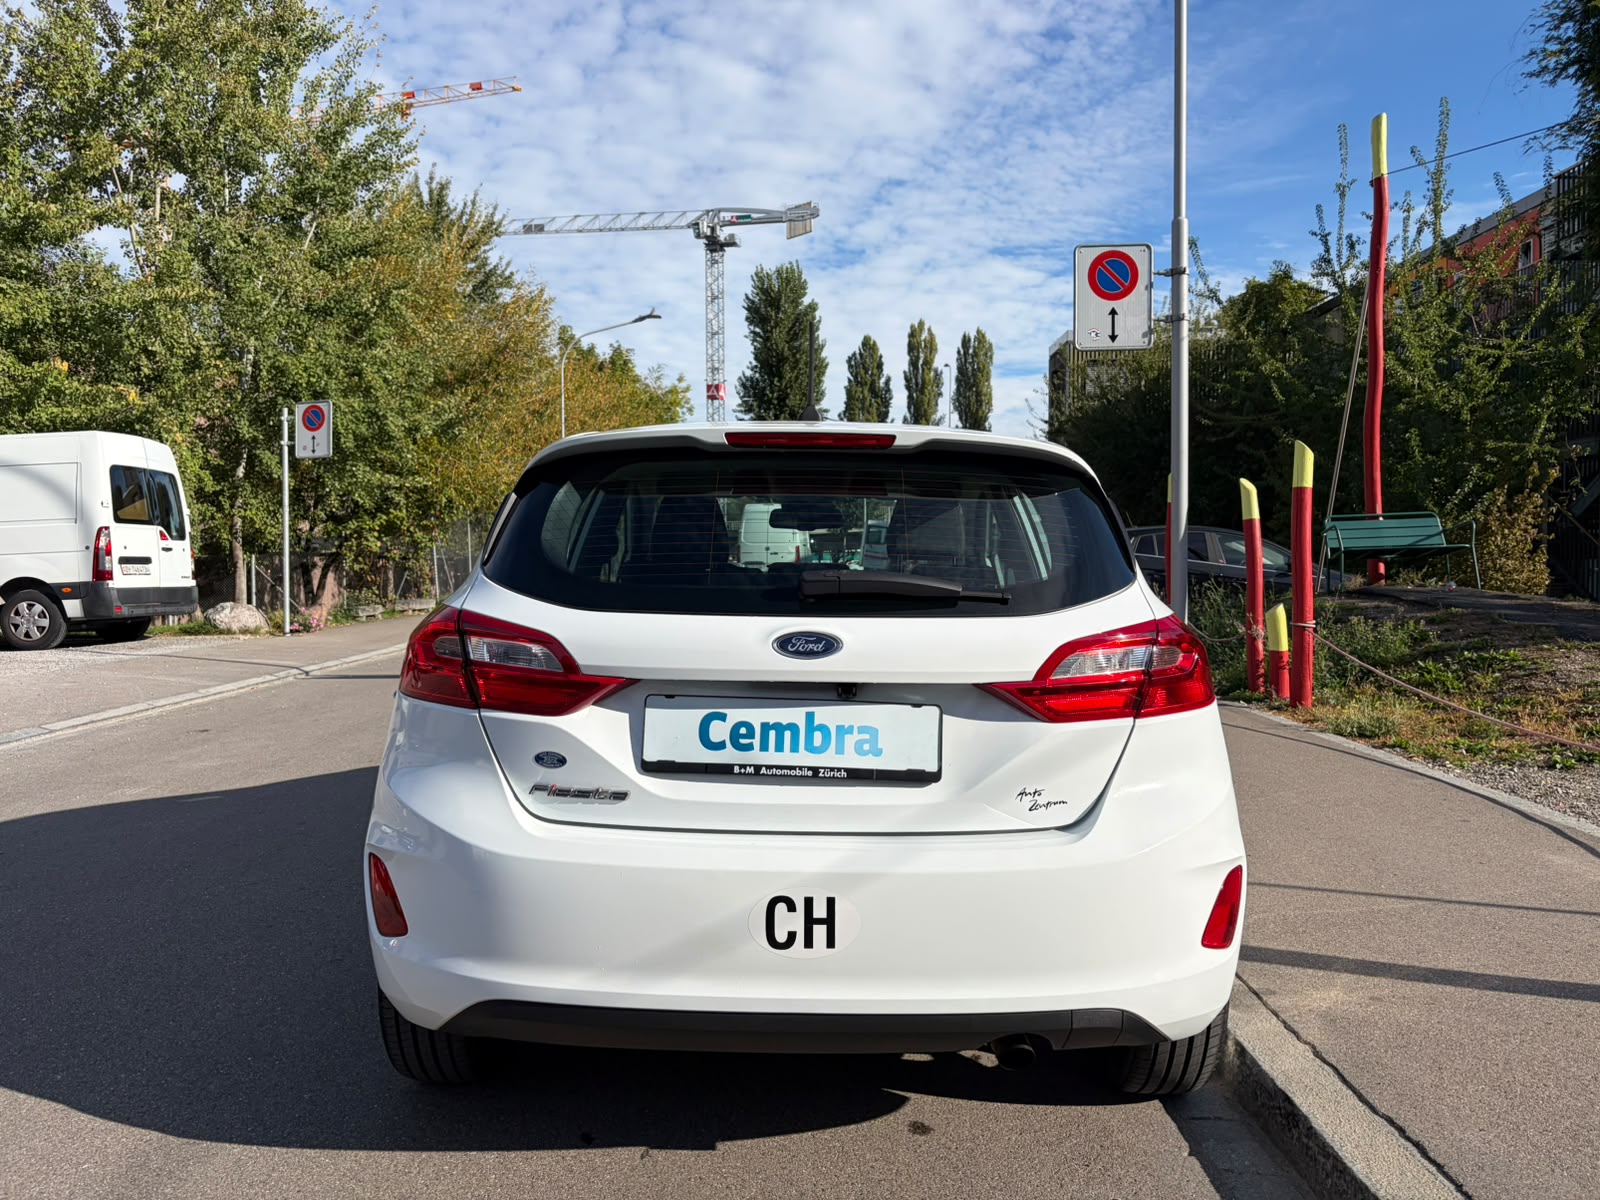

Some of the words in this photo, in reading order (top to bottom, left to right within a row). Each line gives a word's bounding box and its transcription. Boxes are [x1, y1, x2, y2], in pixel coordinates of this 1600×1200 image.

[788, 636, 826, 652] Ford
[698, 711, 883, 757] Cembra
[733, 765, 755, 775] B+M
[760, 766, 813, 777] Automobile
[818, 768, 847, 779] Zürich
[528, 784, 630, 801] Fiesta
[1015, 787, 1045, 802] Auto
[765, 895, 836, 950] CH
